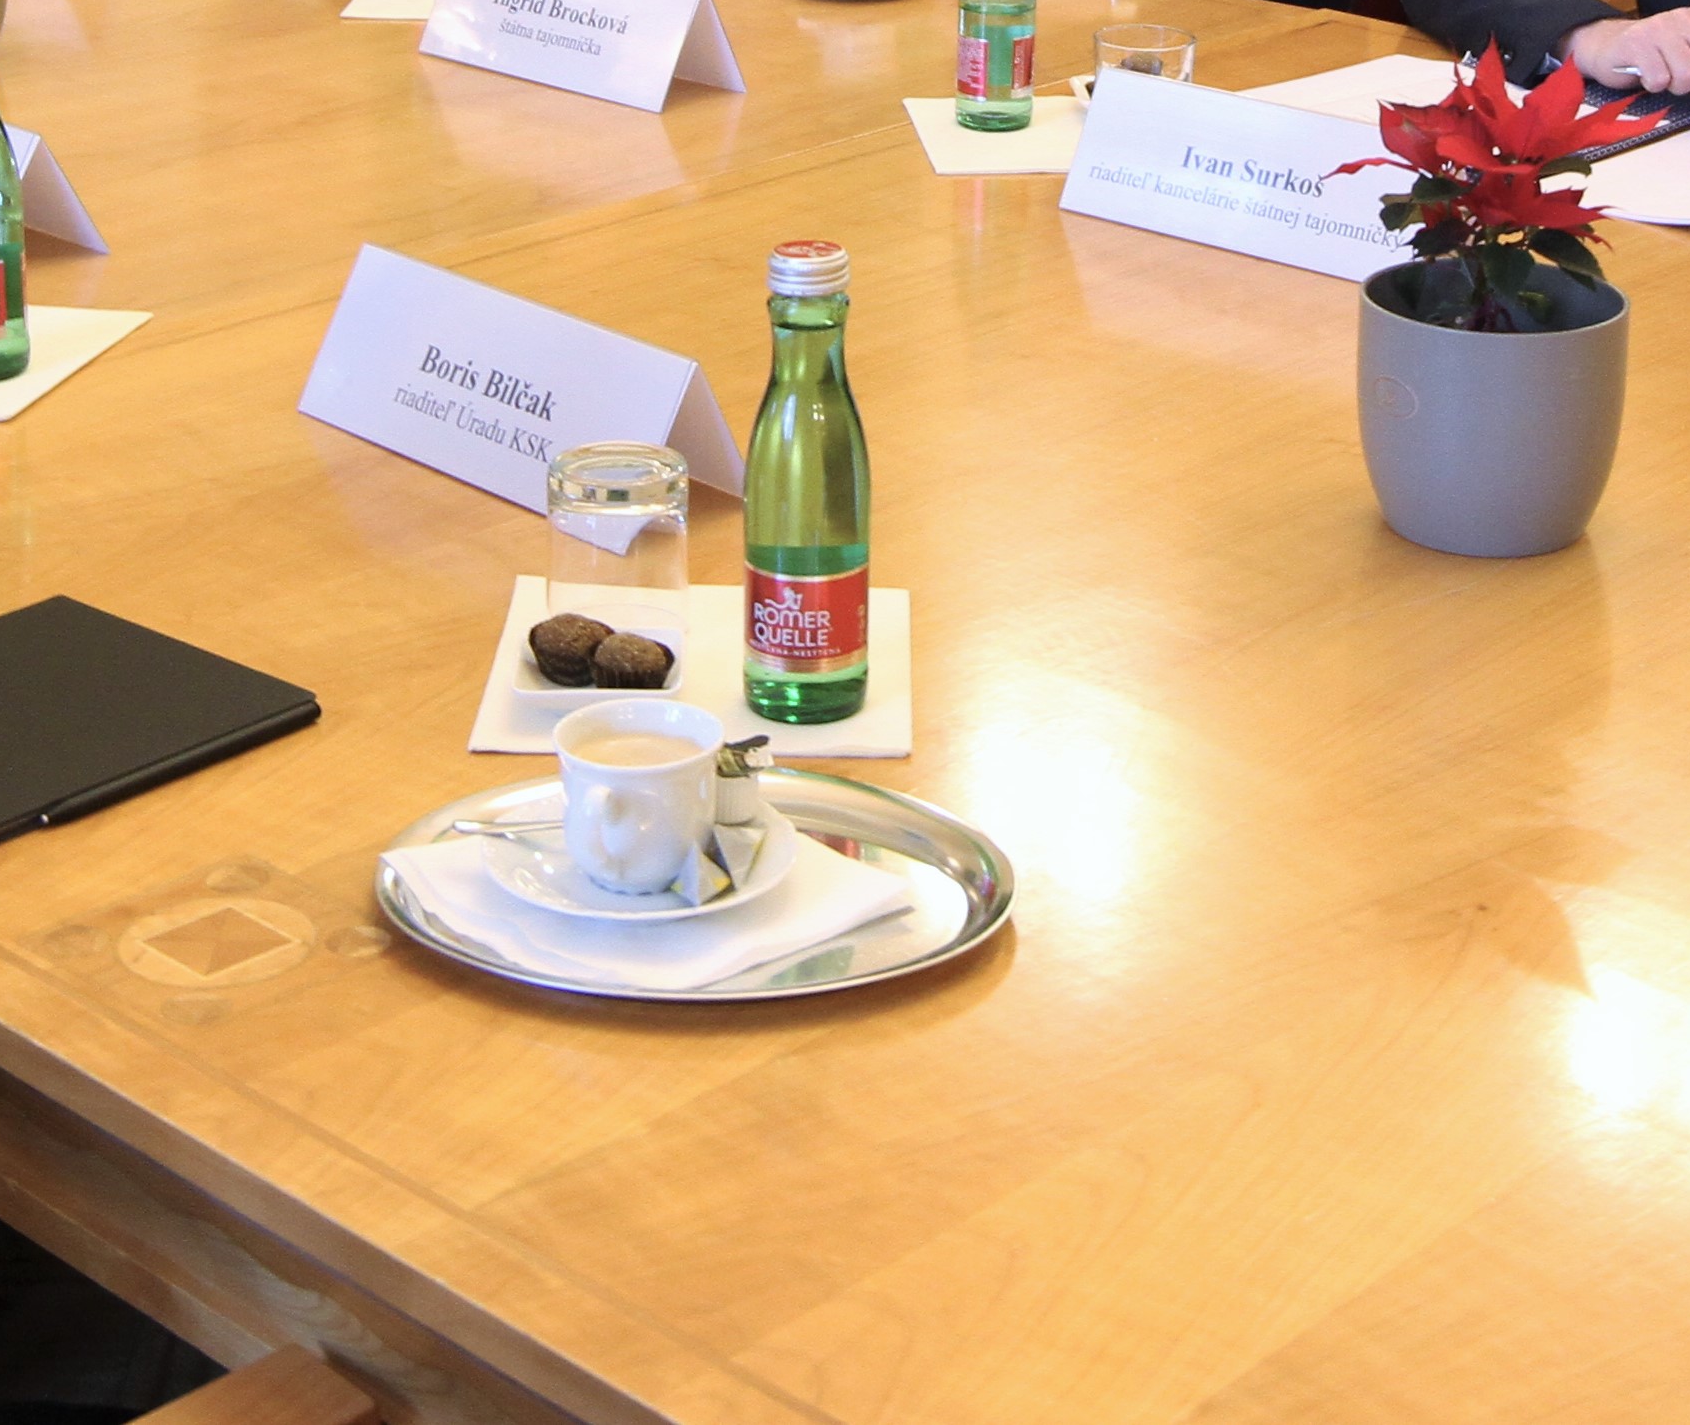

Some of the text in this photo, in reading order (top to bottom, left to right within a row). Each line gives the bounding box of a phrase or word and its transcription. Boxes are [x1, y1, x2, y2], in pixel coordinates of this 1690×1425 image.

[499, 18, 602, 56] štátna tajomníčka
[1181, 145, 1325, 198] Ivan Surkoš
[1089, 161, 1405, 253] riaditeľ kancelárie štátnej tajomníčky
[419, 344, 557, 422] Boris Bilčak
[393, 382, 553, 463] riaditeľ Úradu KSK
[755, 622, 829, 647] QUELLE
